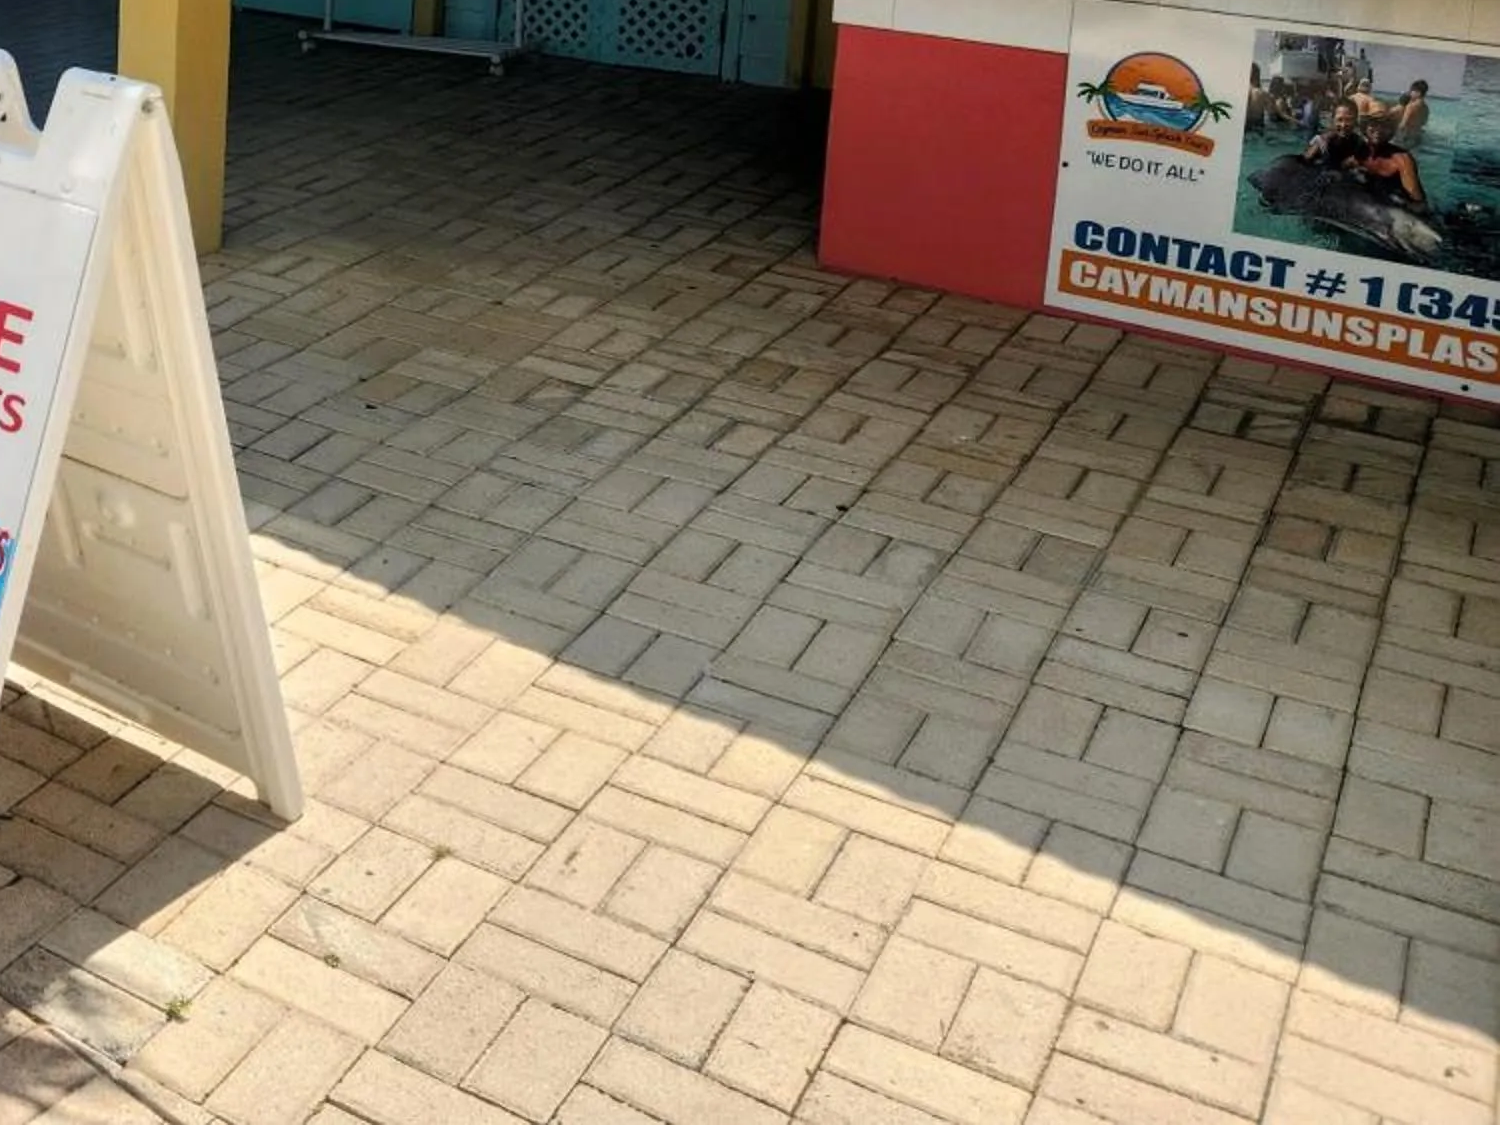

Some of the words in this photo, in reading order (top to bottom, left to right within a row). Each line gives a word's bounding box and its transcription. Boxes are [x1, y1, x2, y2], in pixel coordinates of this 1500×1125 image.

[1086, 150, 1116, 168] "WE
[1119, 156, 1144, 172] DO
[1147, 160, 1163, 175] IT
[1072, 259, 1499, 373] CAYMANSUNSPLAS
[1073, 219, 1295, 290] CONTACT
[1305, 269, 1347, 298] #
[1398, 282, 1500, 331] (34
